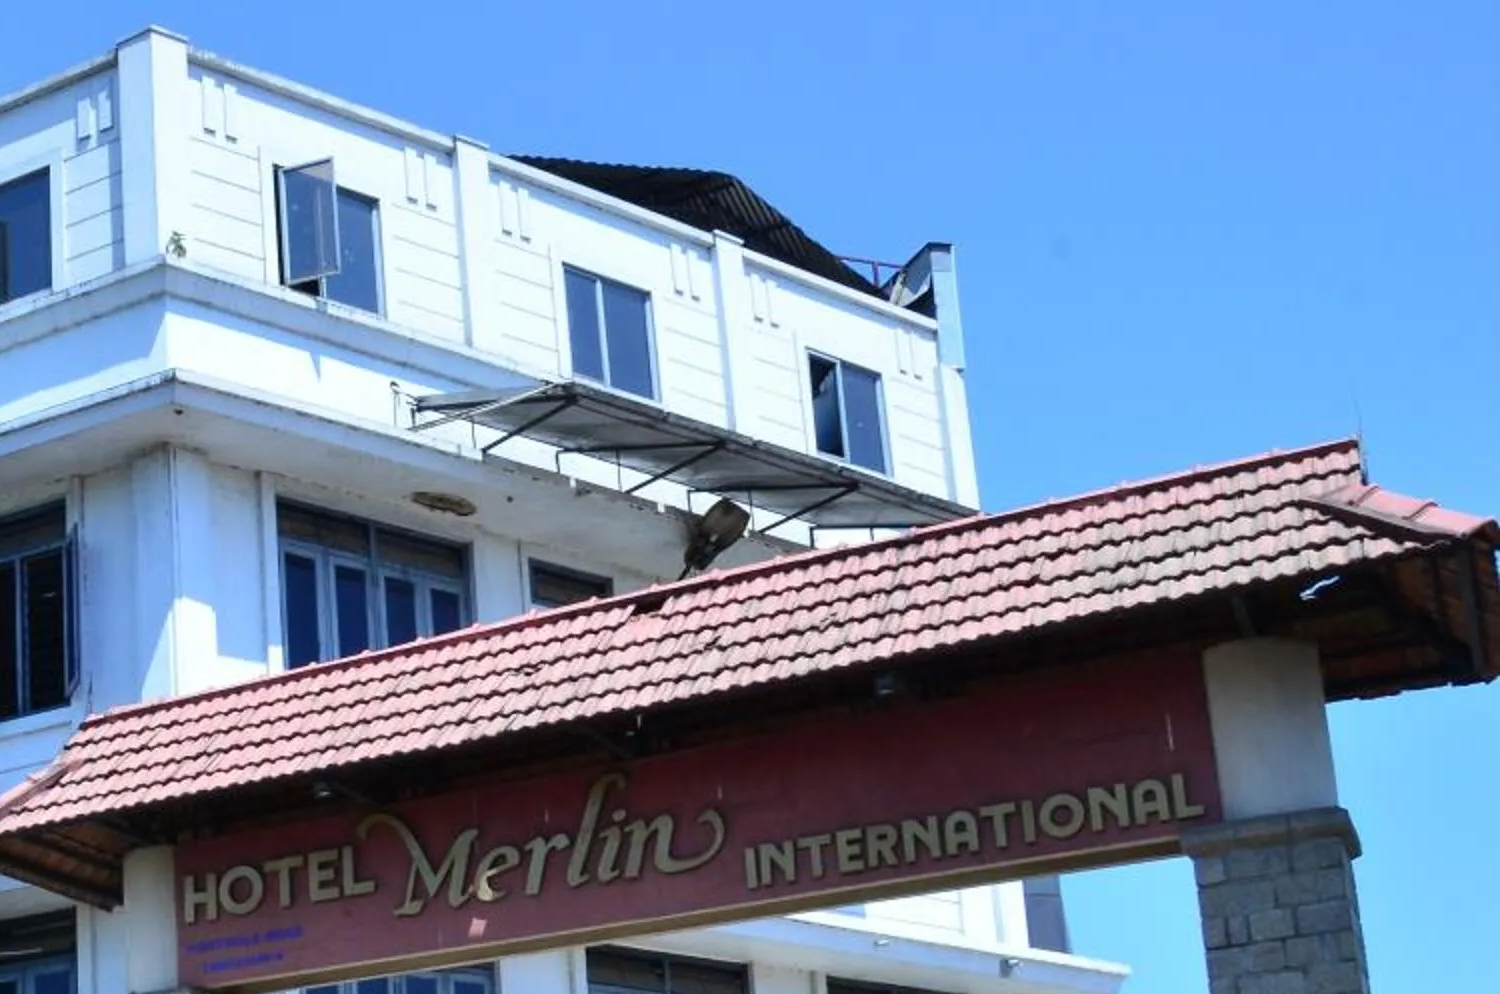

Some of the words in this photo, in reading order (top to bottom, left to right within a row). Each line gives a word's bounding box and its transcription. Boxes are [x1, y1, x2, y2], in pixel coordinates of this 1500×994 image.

[183, 845, 376, 925] HOTEL
[357, 774, 726, 918] Merlin
[744, 773, 1206, 890] INTERNATIONAL
